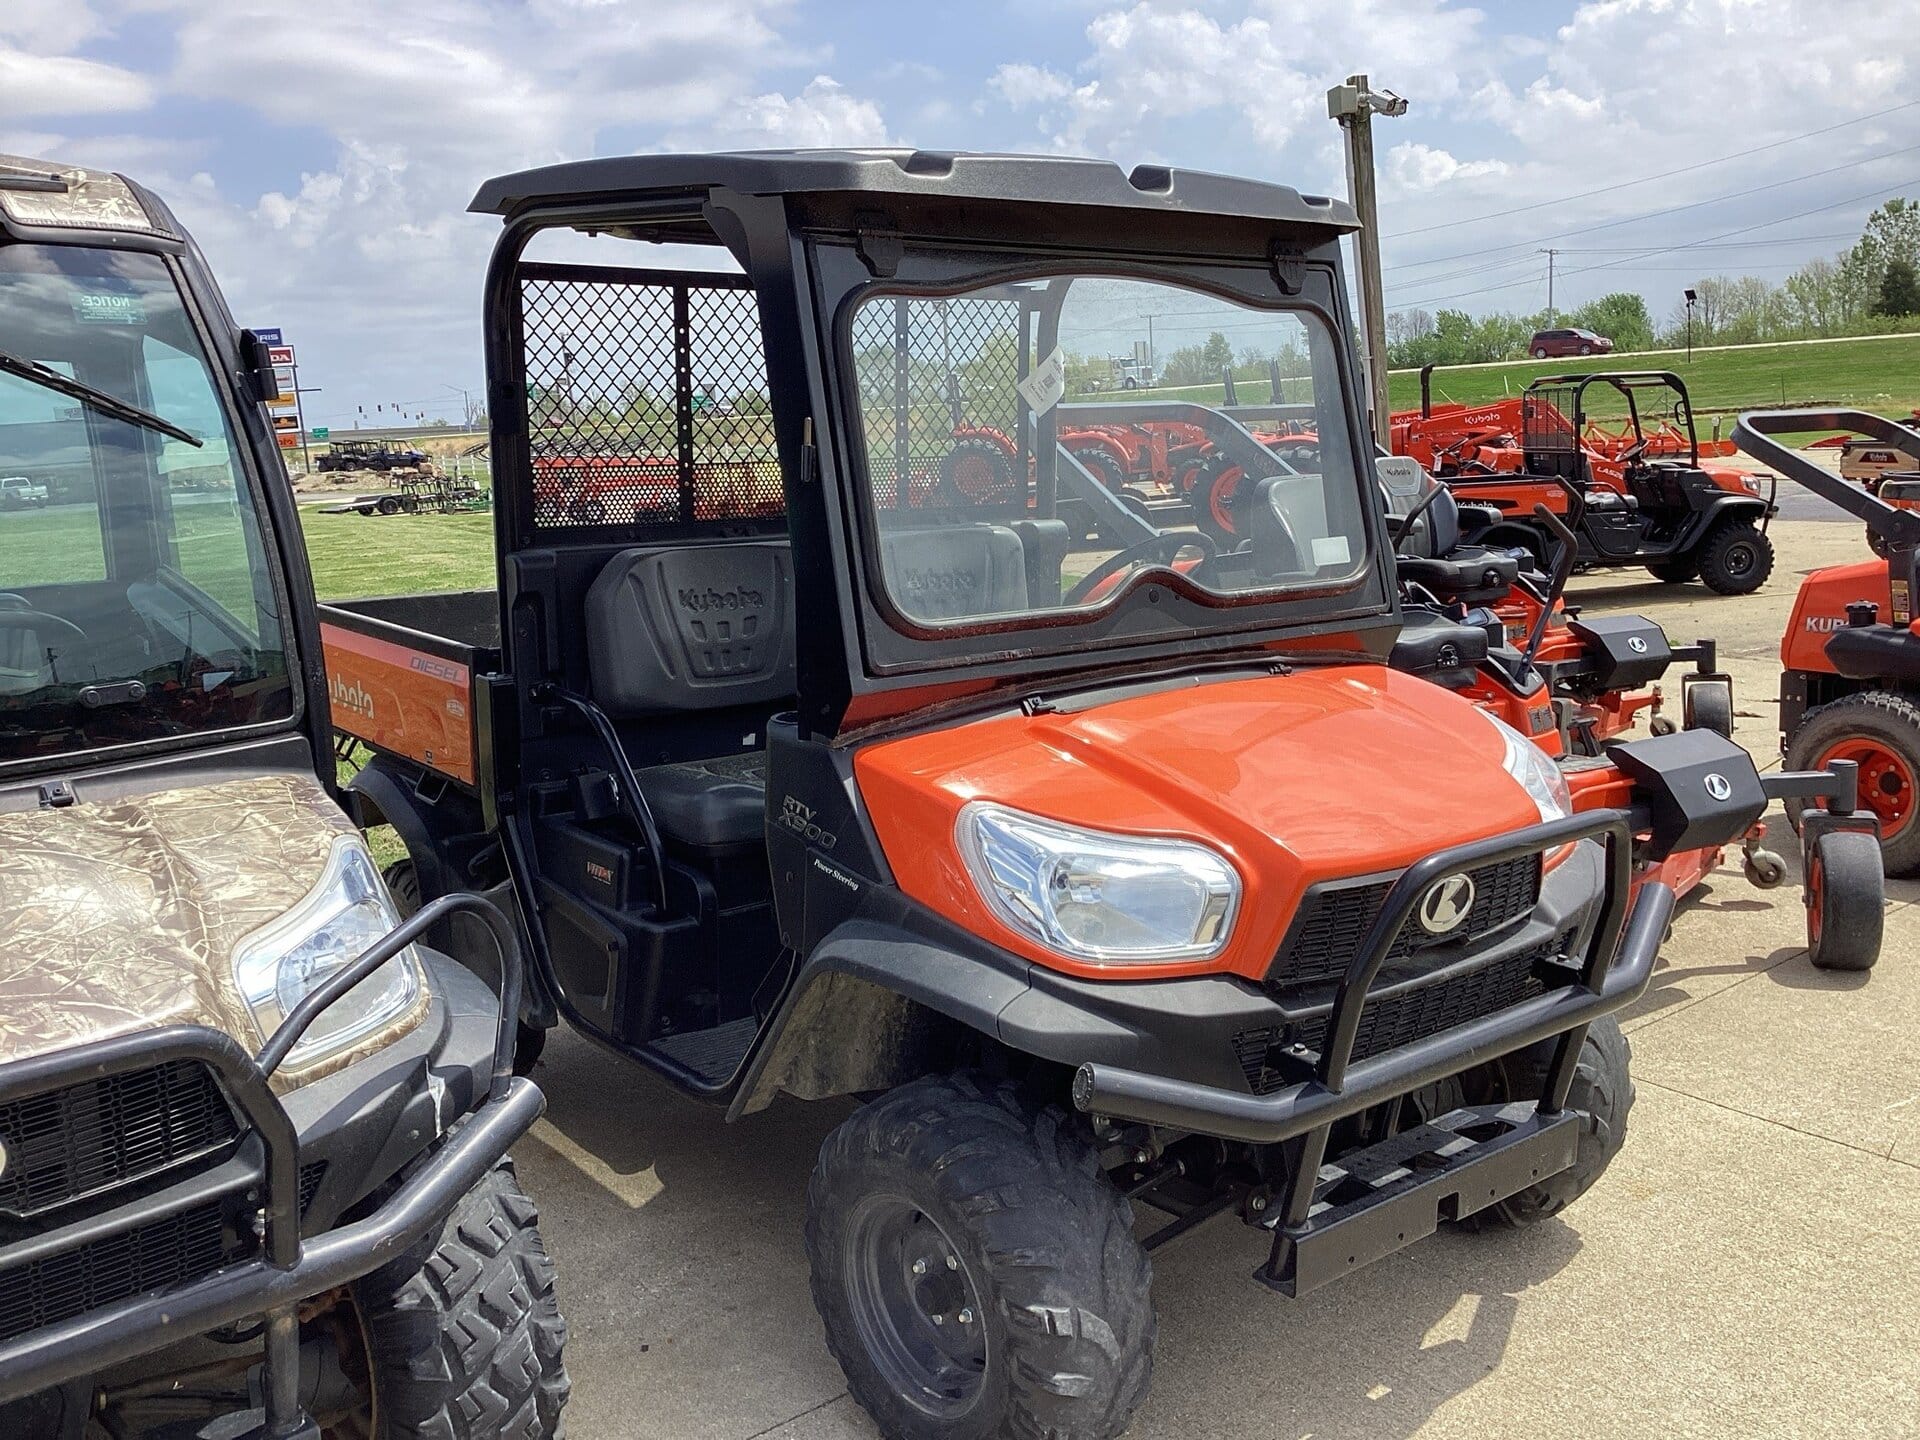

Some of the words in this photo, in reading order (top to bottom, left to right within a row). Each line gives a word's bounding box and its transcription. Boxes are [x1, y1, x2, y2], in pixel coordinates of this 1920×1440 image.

[1464, 412, 1501, 425] Kubota
[679, 587, 763, 612] Kubota
[410, 656, 462, 682] DIESEL
[783, 795, 817, 820] RTV
[779, 807, 836, 849] X900
[814, 858, 834, 875] Power
[831, 870, 859, 891] Steering
